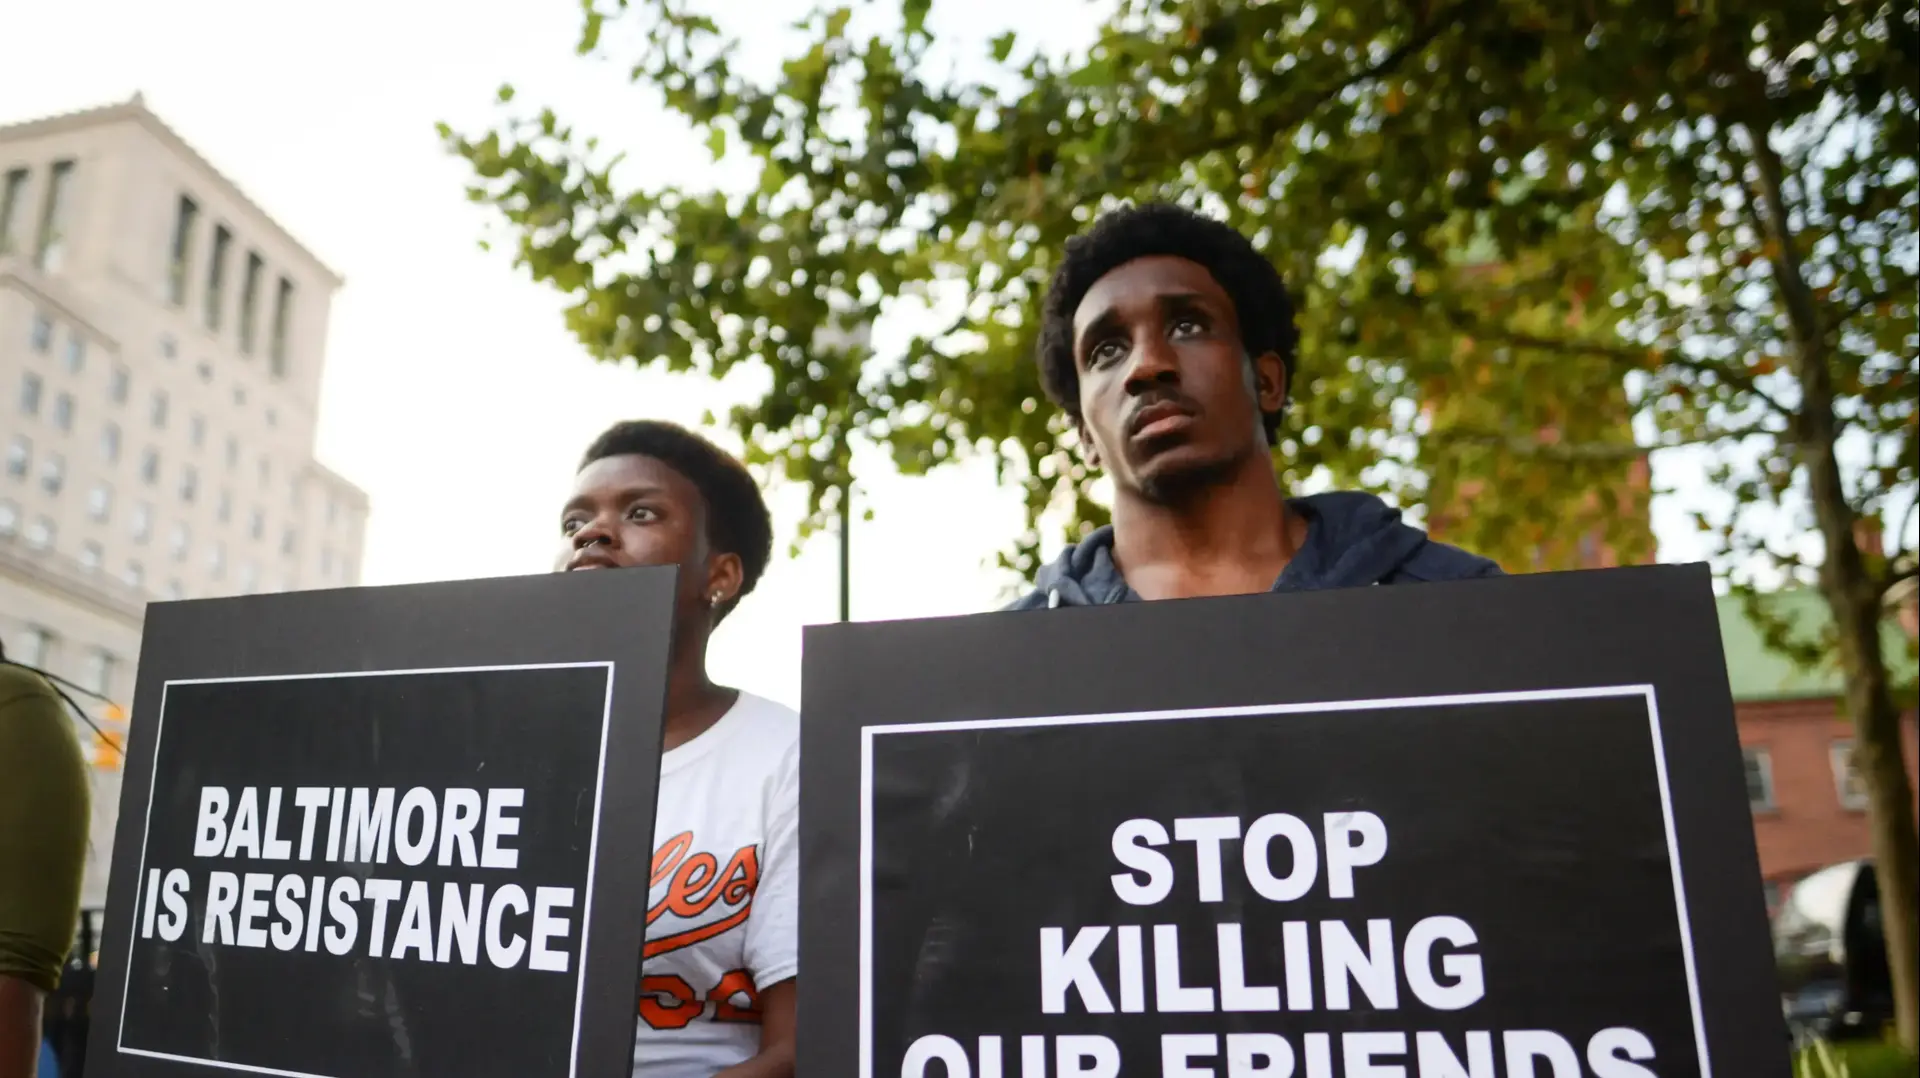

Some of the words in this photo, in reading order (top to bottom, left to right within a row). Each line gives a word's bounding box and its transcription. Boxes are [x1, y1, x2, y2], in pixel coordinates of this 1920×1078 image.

[193, 786, 525, 869] BALTIMORE
[1110, 810, 1388, 906] STOP
[141, 868, 190, 942] IS
[202, 871, 575, 973] RESISTANCE
[1039, 915, 1485, 1014] KILLING
